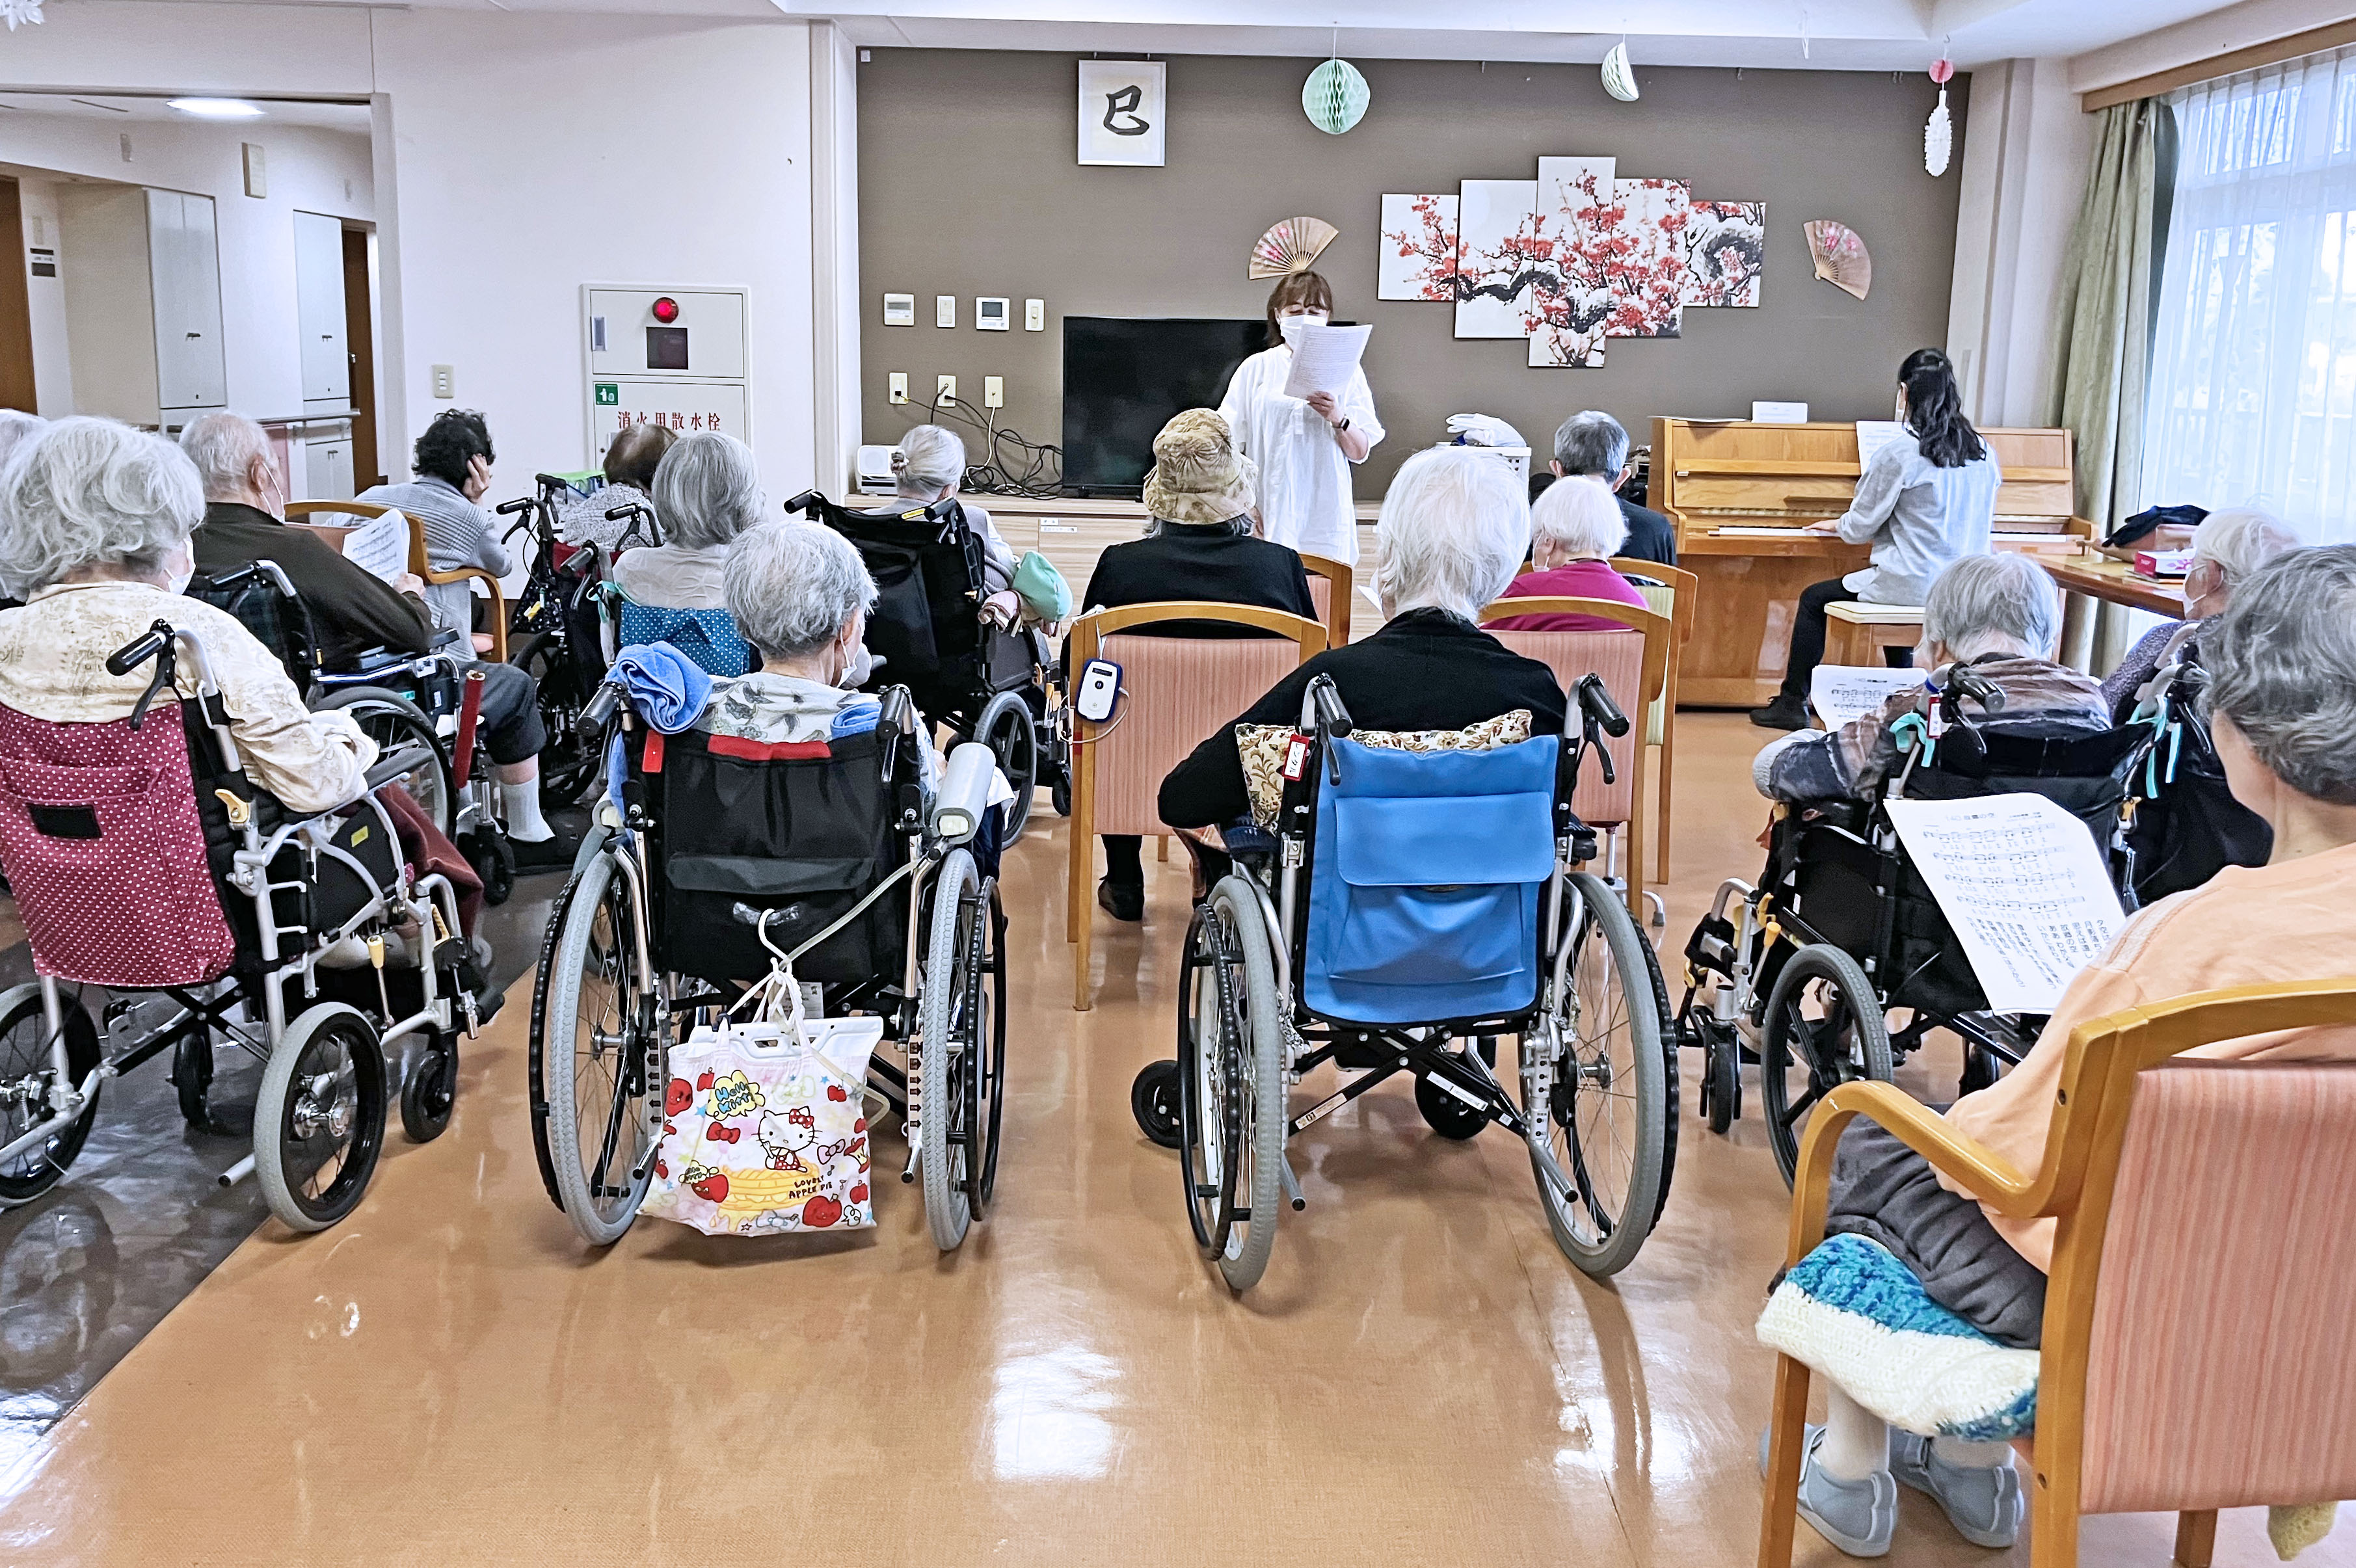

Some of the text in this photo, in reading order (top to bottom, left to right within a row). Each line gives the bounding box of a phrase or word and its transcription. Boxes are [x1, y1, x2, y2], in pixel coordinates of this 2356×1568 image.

[715, 1082, 748, 1102] Hell
[717, 1093, 751, 1115] Kitt
[789, 1181, 833, 1199] APPLE PIE
[794, 1175, 824, 1188] LOVELY
